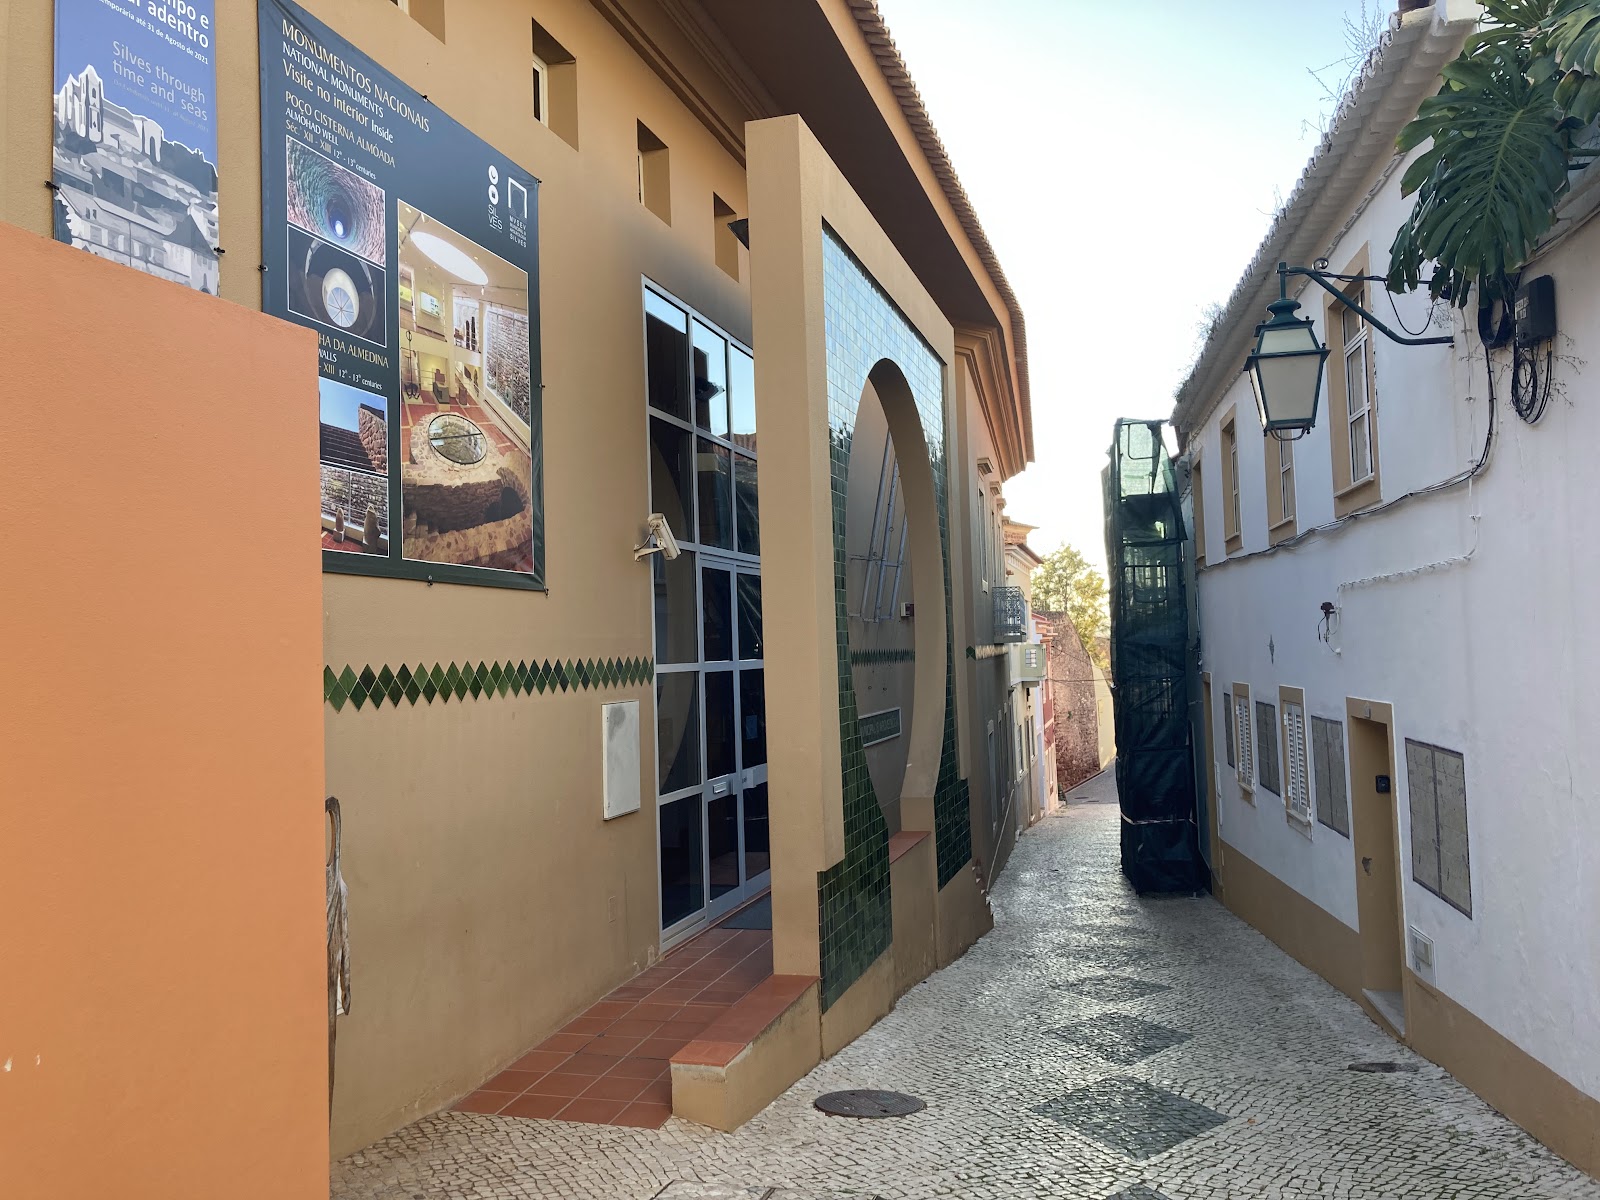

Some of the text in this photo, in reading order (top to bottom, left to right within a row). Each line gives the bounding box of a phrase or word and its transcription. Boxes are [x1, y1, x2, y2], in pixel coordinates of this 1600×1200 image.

[135, 16, 146, 27] até
[147, 23, 154, 33] 31
[156, 29, 163, 37] de
[165, 33, 186, 50] Agosto
[186, 46, 193, 56] de
[194, 52, 208, 65] 2021
[148, 1, 209, 48] adentro
[201, 14, 209, 29] e
[112, 40, 151, 73] Silves
[155, 65, 205, 104] through
[112, 59, 145, 87] time
[150, 82, 175, 103] and
[181, 98, 208, 121] seas
[282, 19, 430, 132] MONUMENTOS NACIONAIS
[282, 41, 384, 118] NATIONAL MONUMENTS
[282, 59, 394, 144] Visite no interior Inside
[285, 107, 339, 146] ALMOHAD WELL
[285, 91, 396, 168] POÇO CISTERNA ALMÓADA
[303, 129, 314, 144] XII
[355, 164, 377, 180] centuries
[488, 204, 499, 218] SIL
[488, 213, 503, 230] VES
[318, 332, 389, 368] HA DA ALMEDINA
[323, 362, 335, 375] XIII
[361, 378, 382, 390] centuries
